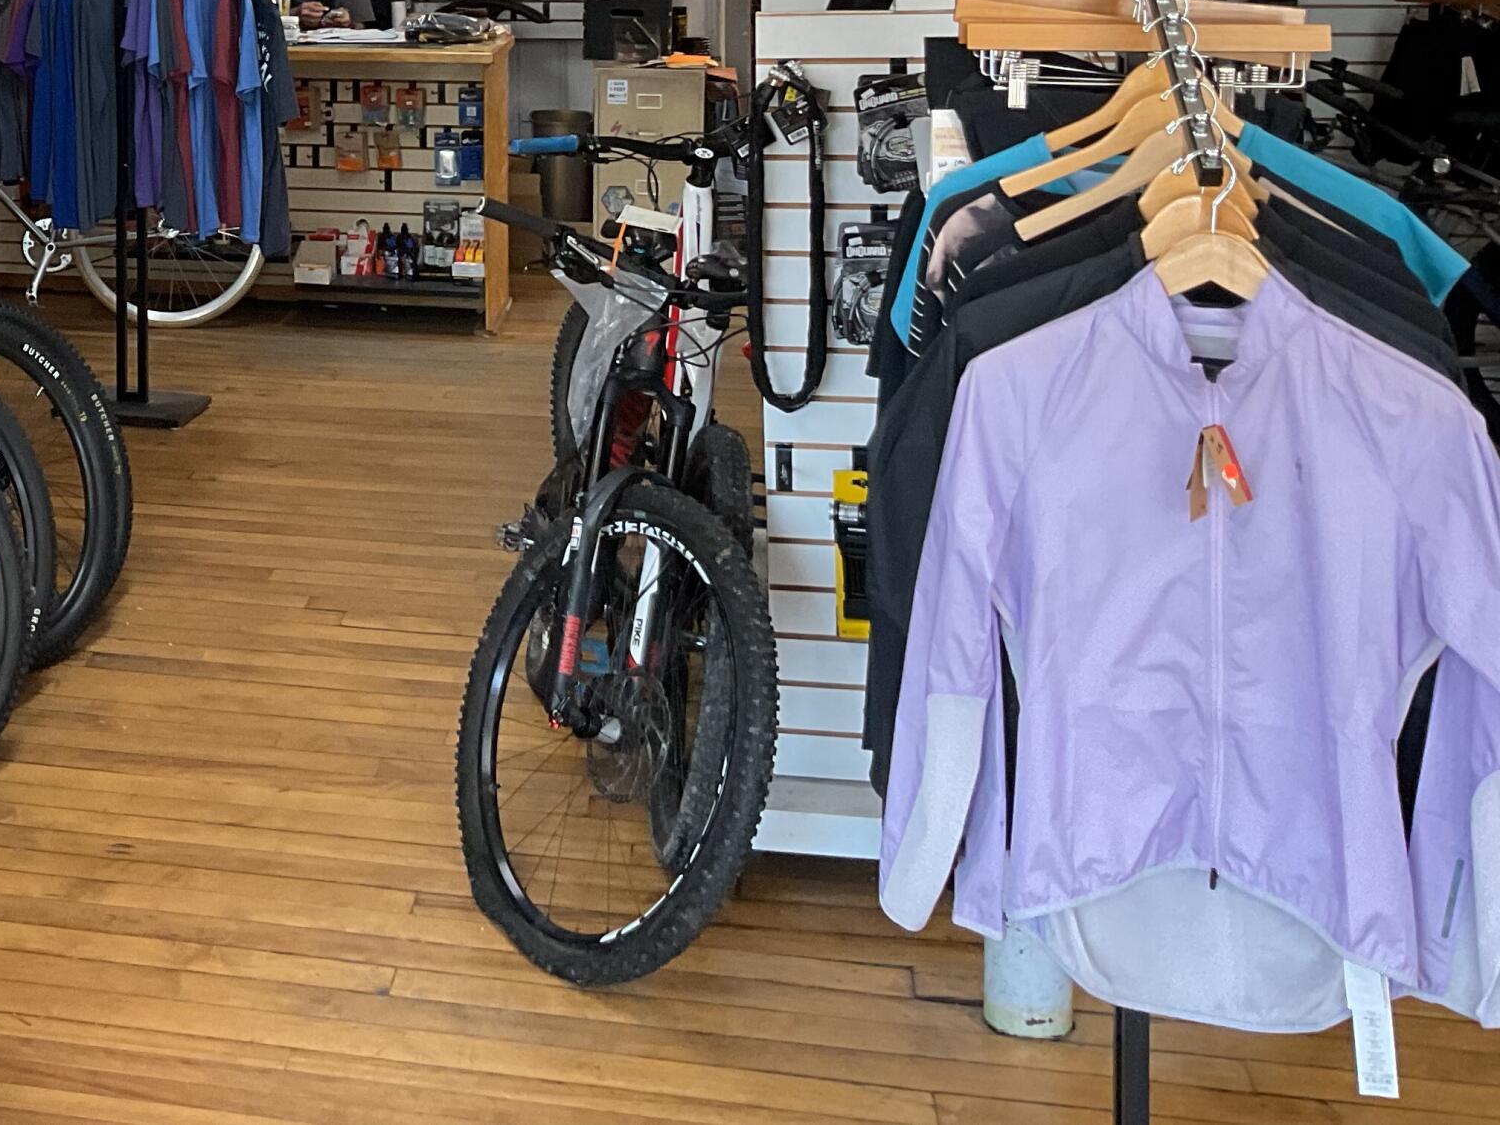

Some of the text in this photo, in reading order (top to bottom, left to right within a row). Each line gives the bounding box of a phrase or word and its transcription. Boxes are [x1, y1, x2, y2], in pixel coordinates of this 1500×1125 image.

[22, 343, 60, 379] BUTCHER
[91, 393, 115, 441] BUTCHER
[632, 618, 644, 647] PIKE
